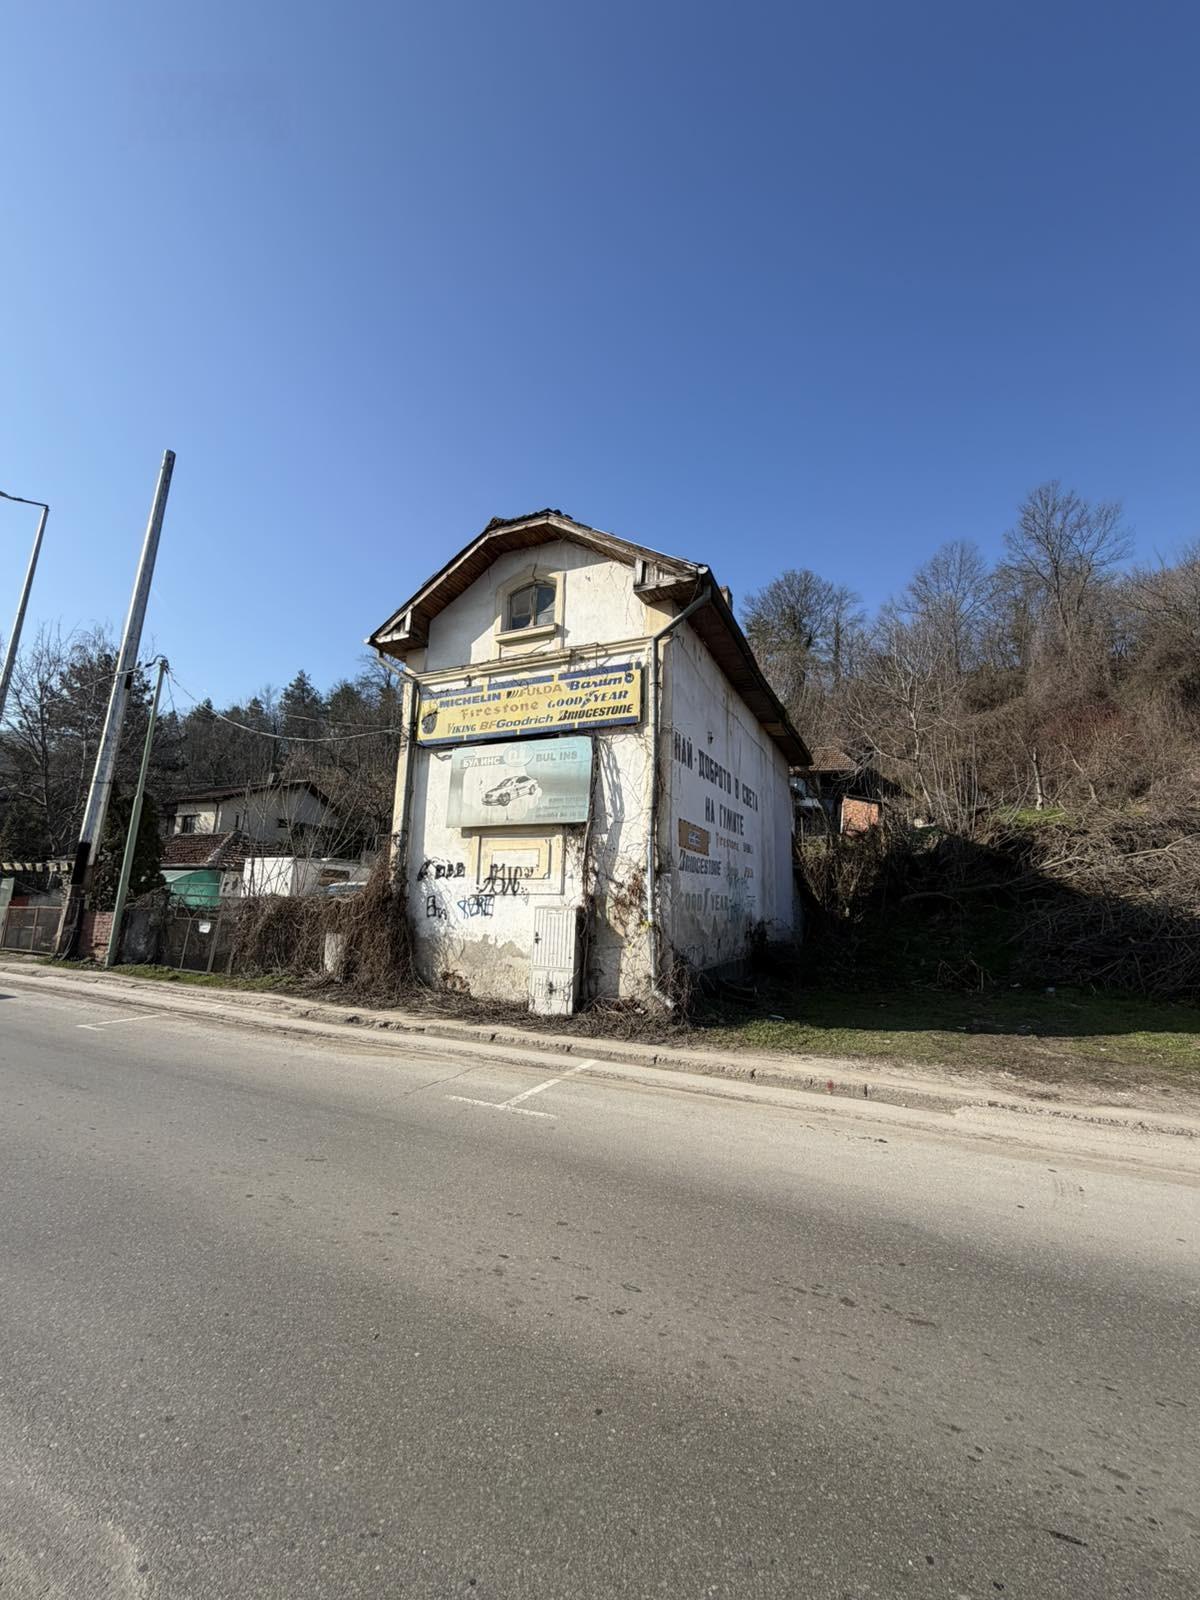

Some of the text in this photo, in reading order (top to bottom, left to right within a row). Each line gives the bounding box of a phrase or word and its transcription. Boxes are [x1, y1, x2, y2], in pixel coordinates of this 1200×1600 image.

[439, 676, 622, 708] MICHELIN FULDA Barum
[461, 700, 539, 720] Firestone
[479, 714, 554, 731] BFGoodrich
[557, 703, 634, 721] BRIDGESTONE
[535, 753, 556, 762] BUL
[742, 782, 759, 812] СВЕТА
[705, 796, 745, 836] НА ГУМИТЕ
